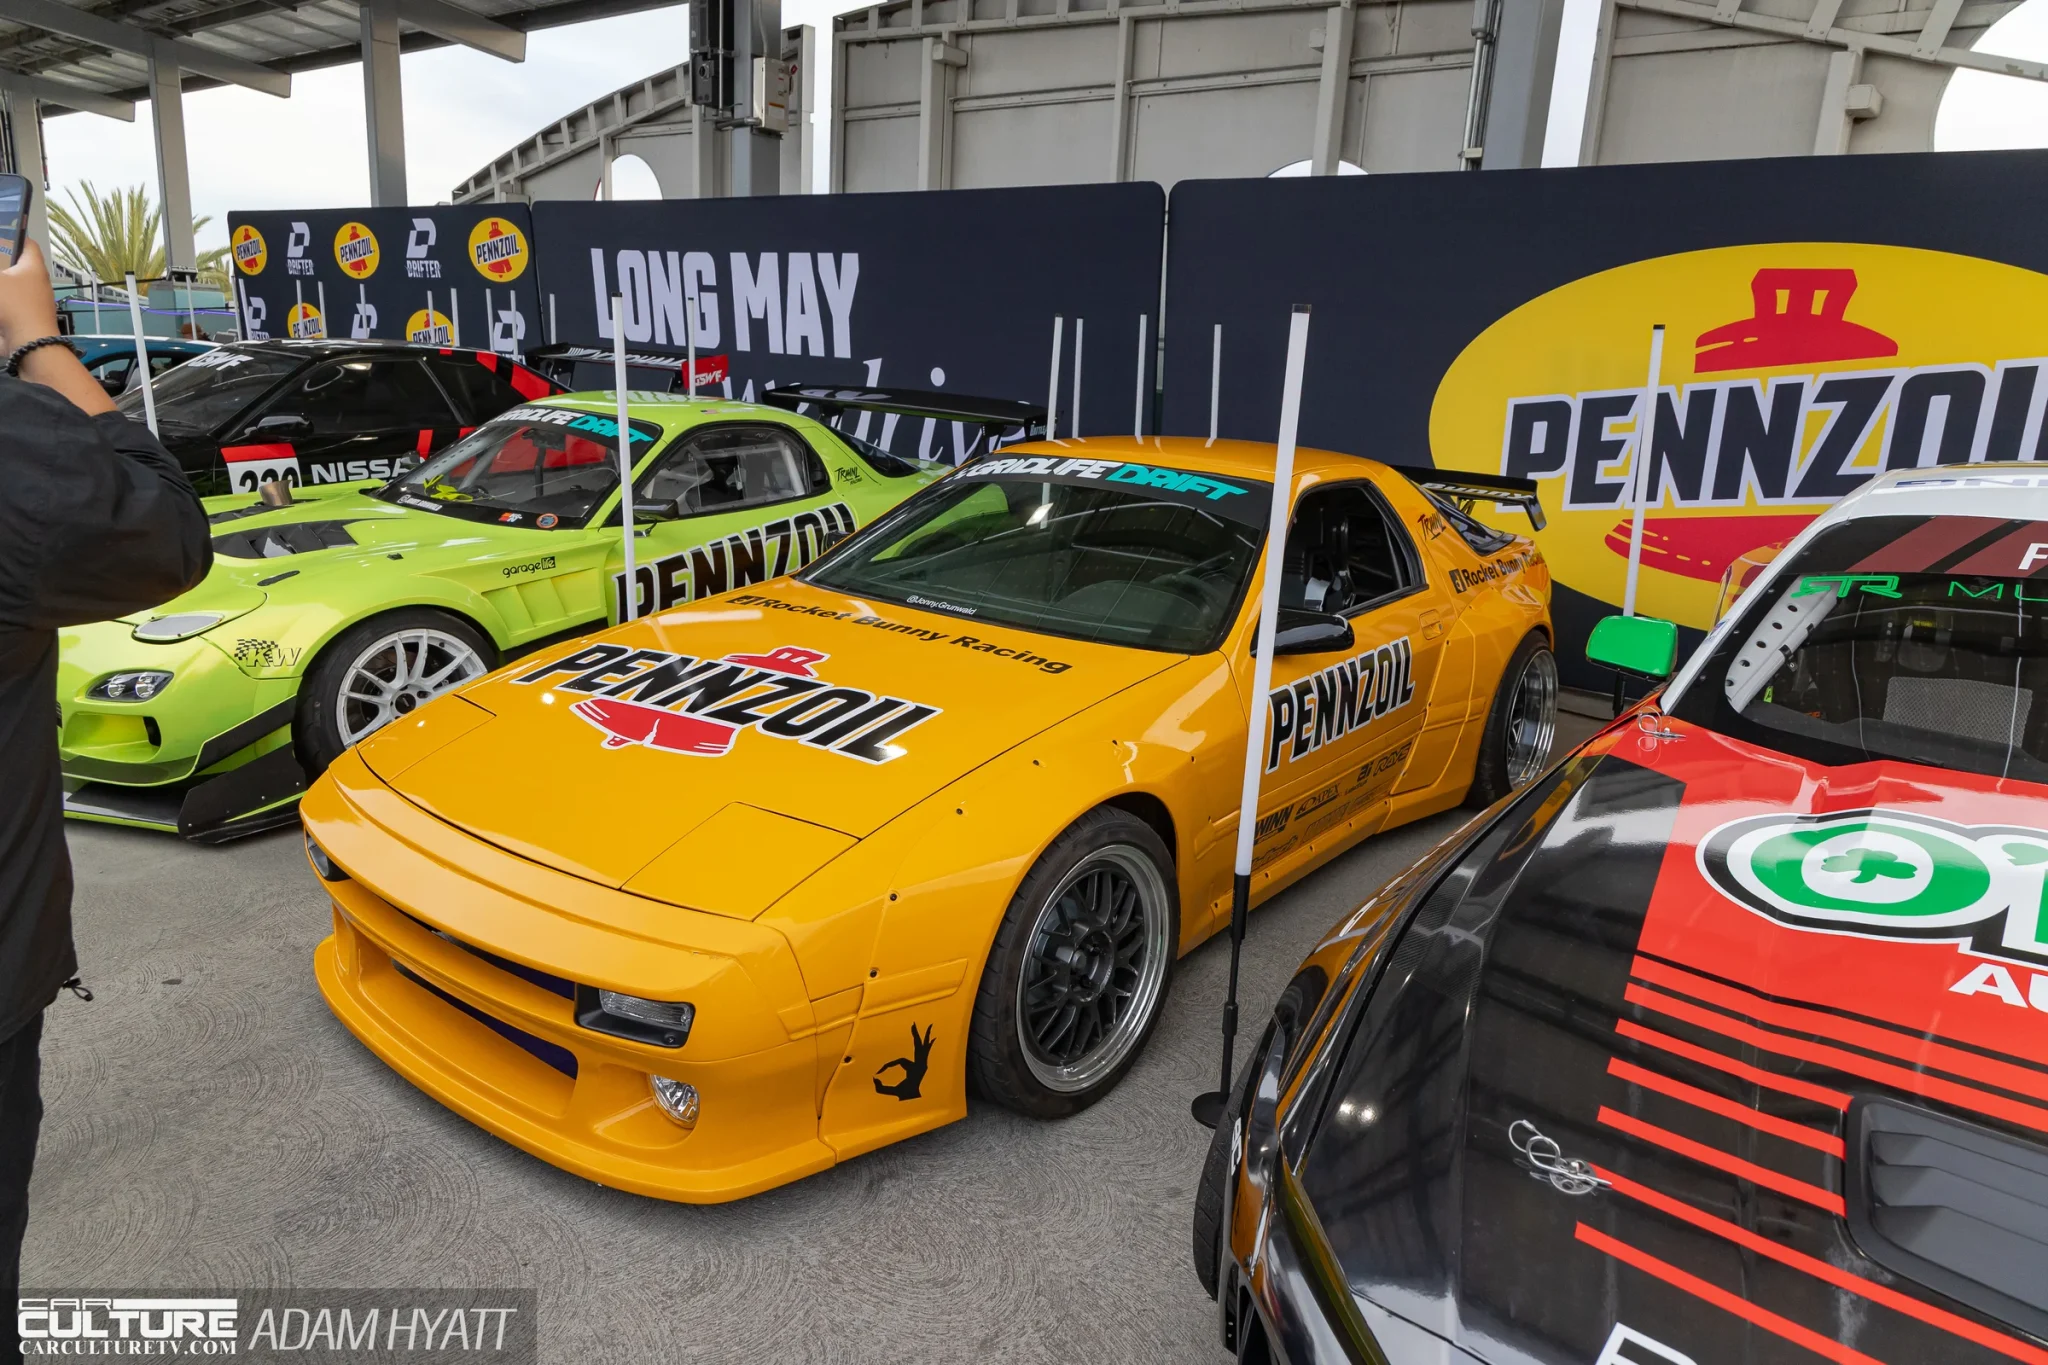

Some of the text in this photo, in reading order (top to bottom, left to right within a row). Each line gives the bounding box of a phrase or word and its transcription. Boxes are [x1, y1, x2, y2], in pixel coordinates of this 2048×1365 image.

[236, 237, 262, 262] PENNZOIL
[340, 240, 374, 264] PENNZOIL
[475, 238, 522, 265] PENNZOIL
[286, 258, 315, 276] DRIFTER
[405, 259, 442, 279] DRIFTER
[590, 248, 860, 359] LONG MAY
[1496, 358, 2048, 513] PENNZOI
[1106, 463, 1249, 501] DRIFT
[1460, 561, 1498, 587] Rocket
[757, 598, 1074, 675] Rocket Bunny Racing
[509, 643, 944, 766] PENNZOIL
[1266, 636, 1417, 775] PENNZOIL
